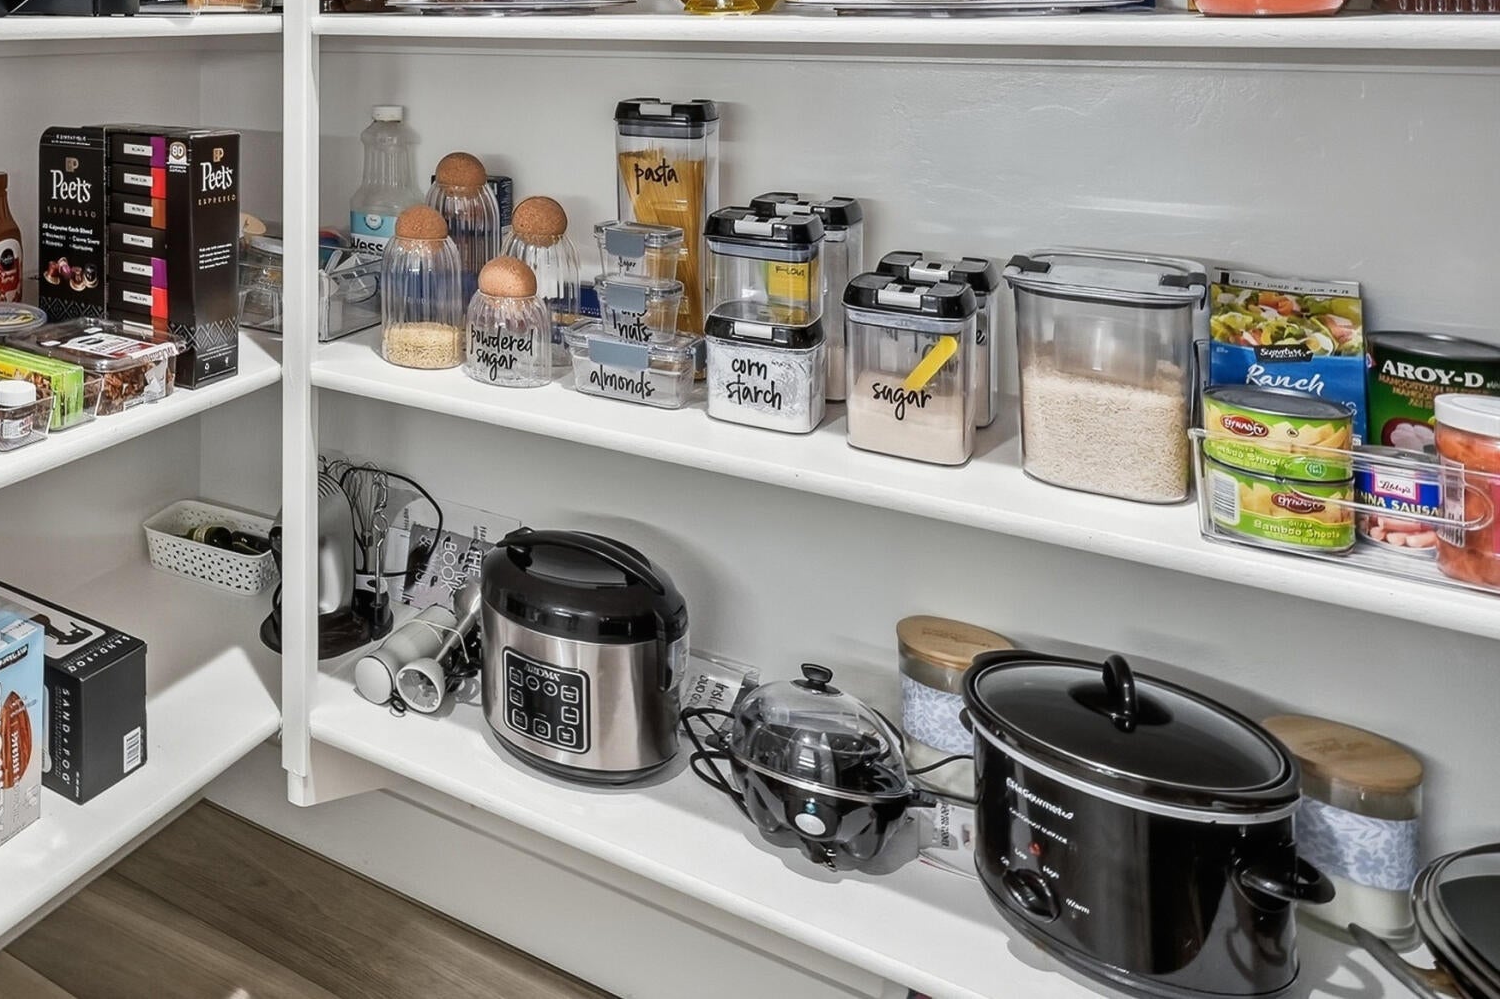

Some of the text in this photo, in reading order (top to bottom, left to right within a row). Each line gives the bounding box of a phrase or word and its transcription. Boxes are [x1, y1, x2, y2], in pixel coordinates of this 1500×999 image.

[49, 168, 93, 204] Peet's
[199, 161, 234, 193] Peet's
[633, 157, 679, 195] pasta
[470, 325, 535, 357] powdered
[618, 317, 653, 343] nuts
[476, 350, 519, 382] sugar
[590, 364, 656, 400] almonds
[730, 355, 769, 381] corn
[1245, 363, 1325, 397] Ranch
[1381, 358, 1485, 389] AROY-D
[725, 378, 783, 411] starch
[871, 382, 933, 421] sugar
[440, 541, 458, 594] BOOK
